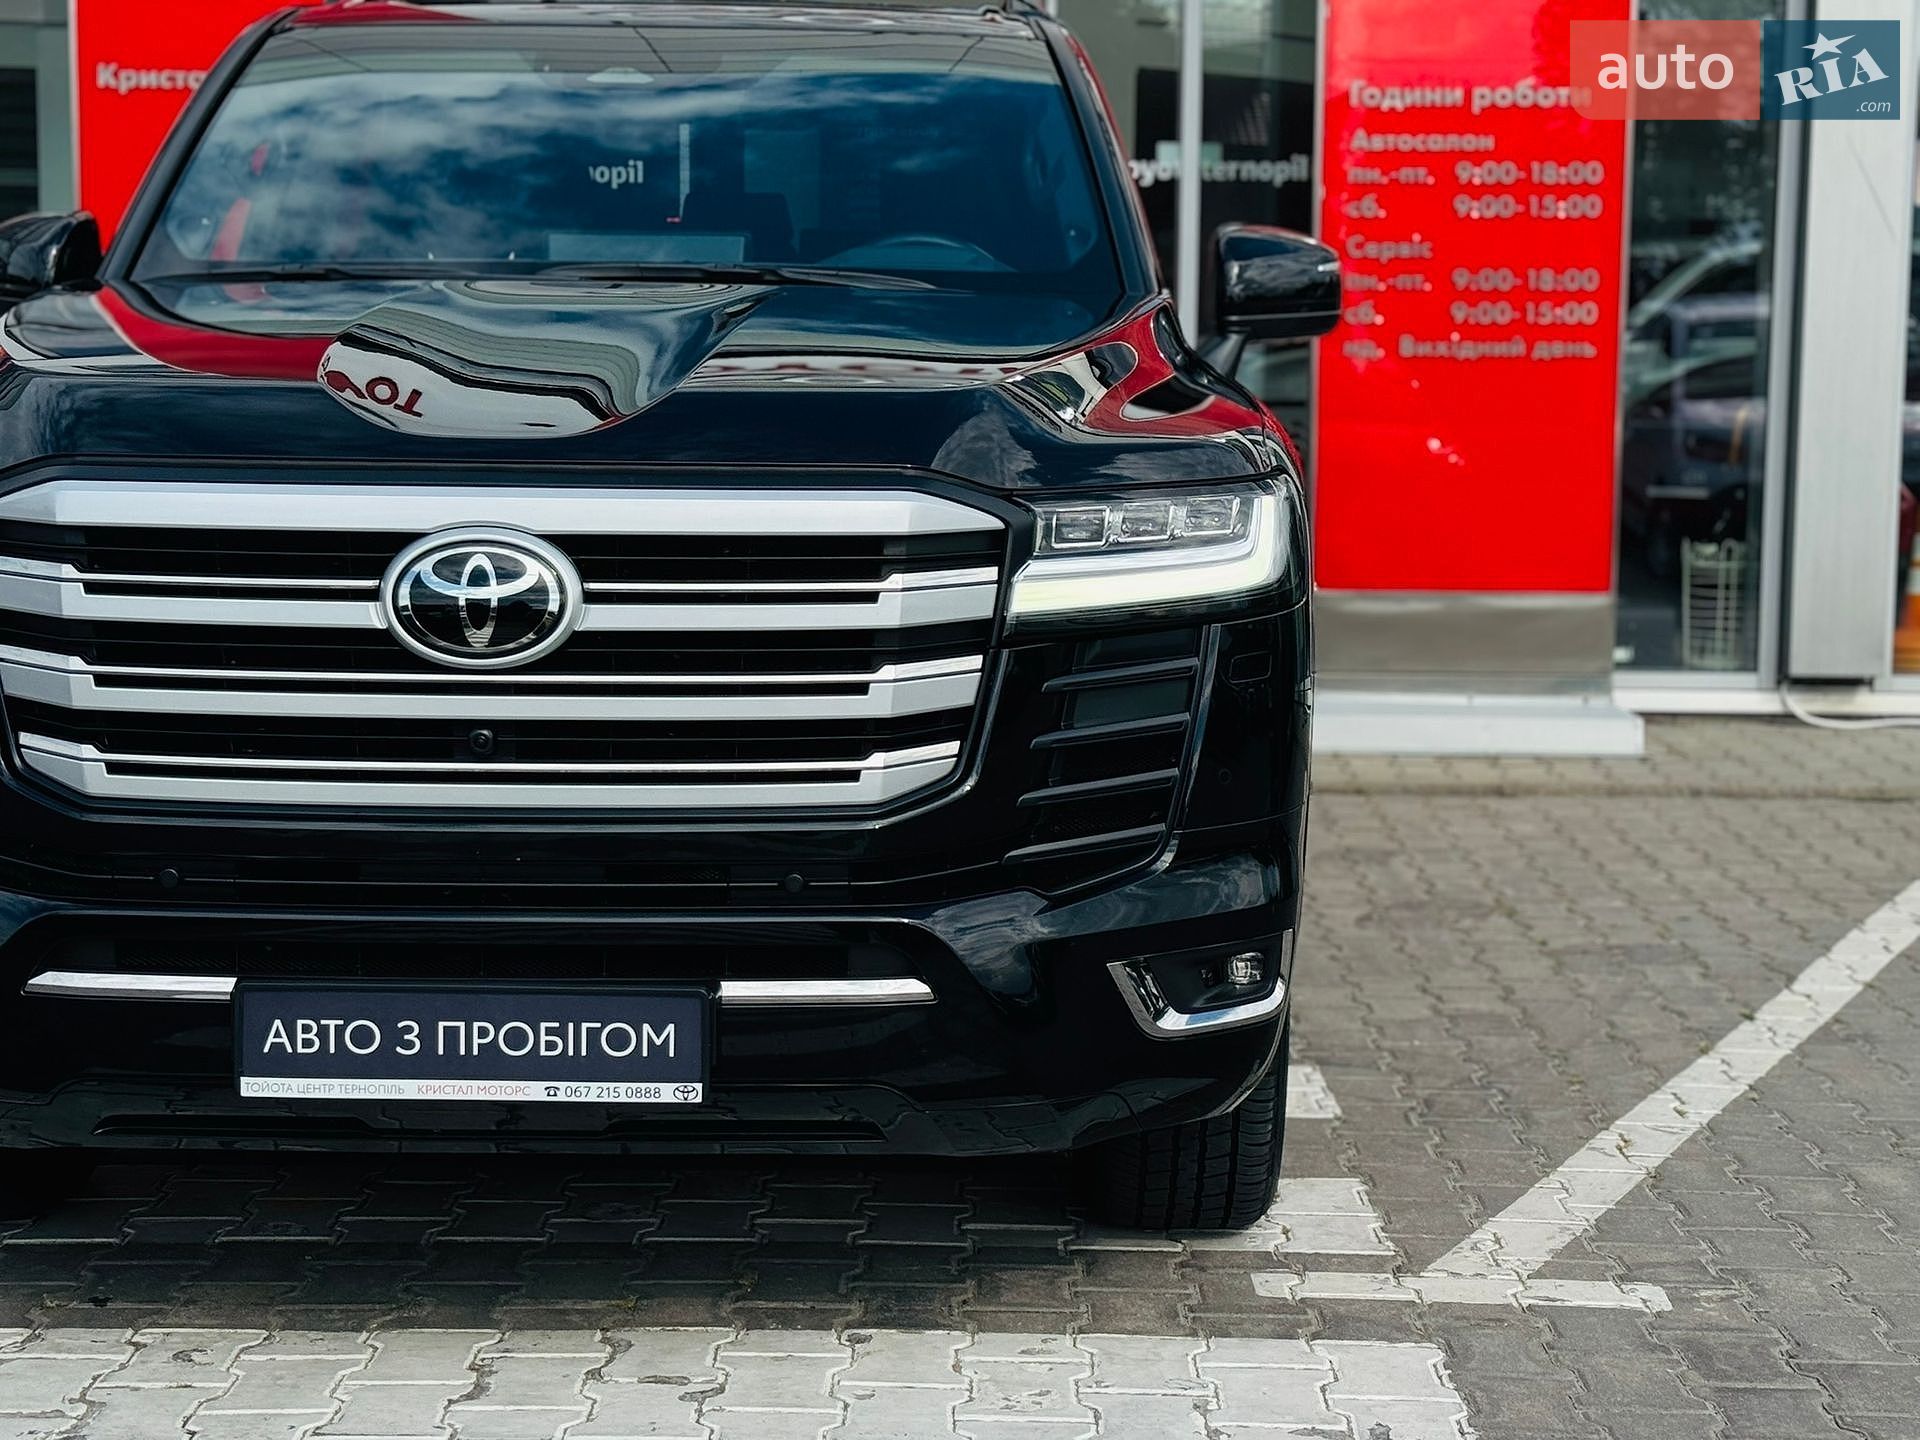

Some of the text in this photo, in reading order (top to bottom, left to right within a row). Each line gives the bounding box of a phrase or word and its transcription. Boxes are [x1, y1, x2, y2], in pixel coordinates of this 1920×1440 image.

[1349, 79, 1464, 112] Години
[1350, 127, 1496, 152] Автосалон
[263, 1018, 381, 1055] АВТО
[437, 1020, 677, 1058] ПРОБІГОМ
[244, 1081, 662, 1100] ТОЙОТА ЦЕНТР ТЕРНОПІЛЬ КРИСТАЛ МОТОРС 067 215 0888
